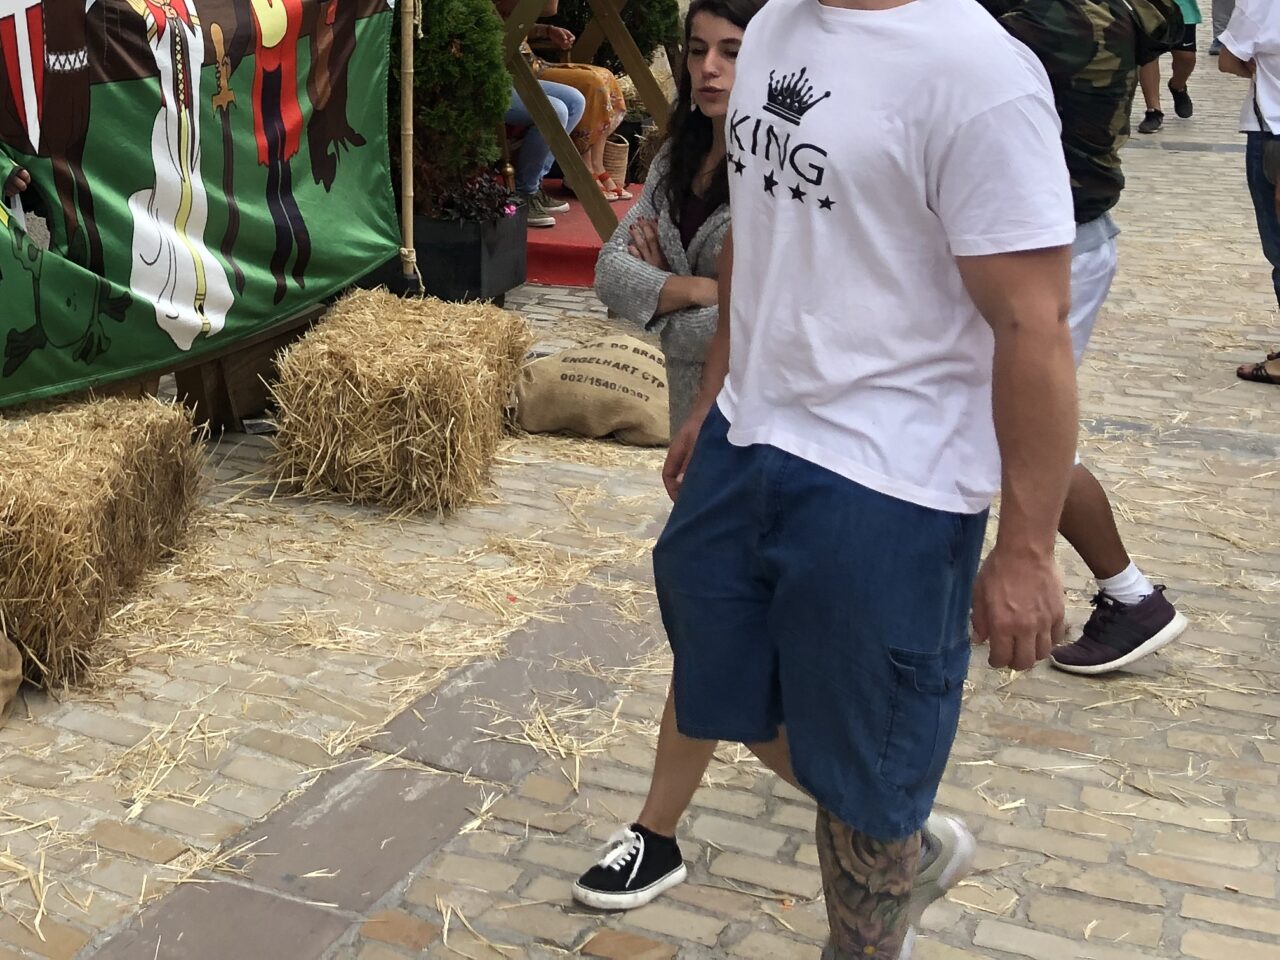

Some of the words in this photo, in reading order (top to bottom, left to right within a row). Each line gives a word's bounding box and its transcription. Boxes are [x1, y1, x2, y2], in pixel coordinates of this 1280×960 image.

[729, 108, 828, 186] KING
[561, 356, 639, 375] ENGELHART
[642, 371, 665, 389] CTP
